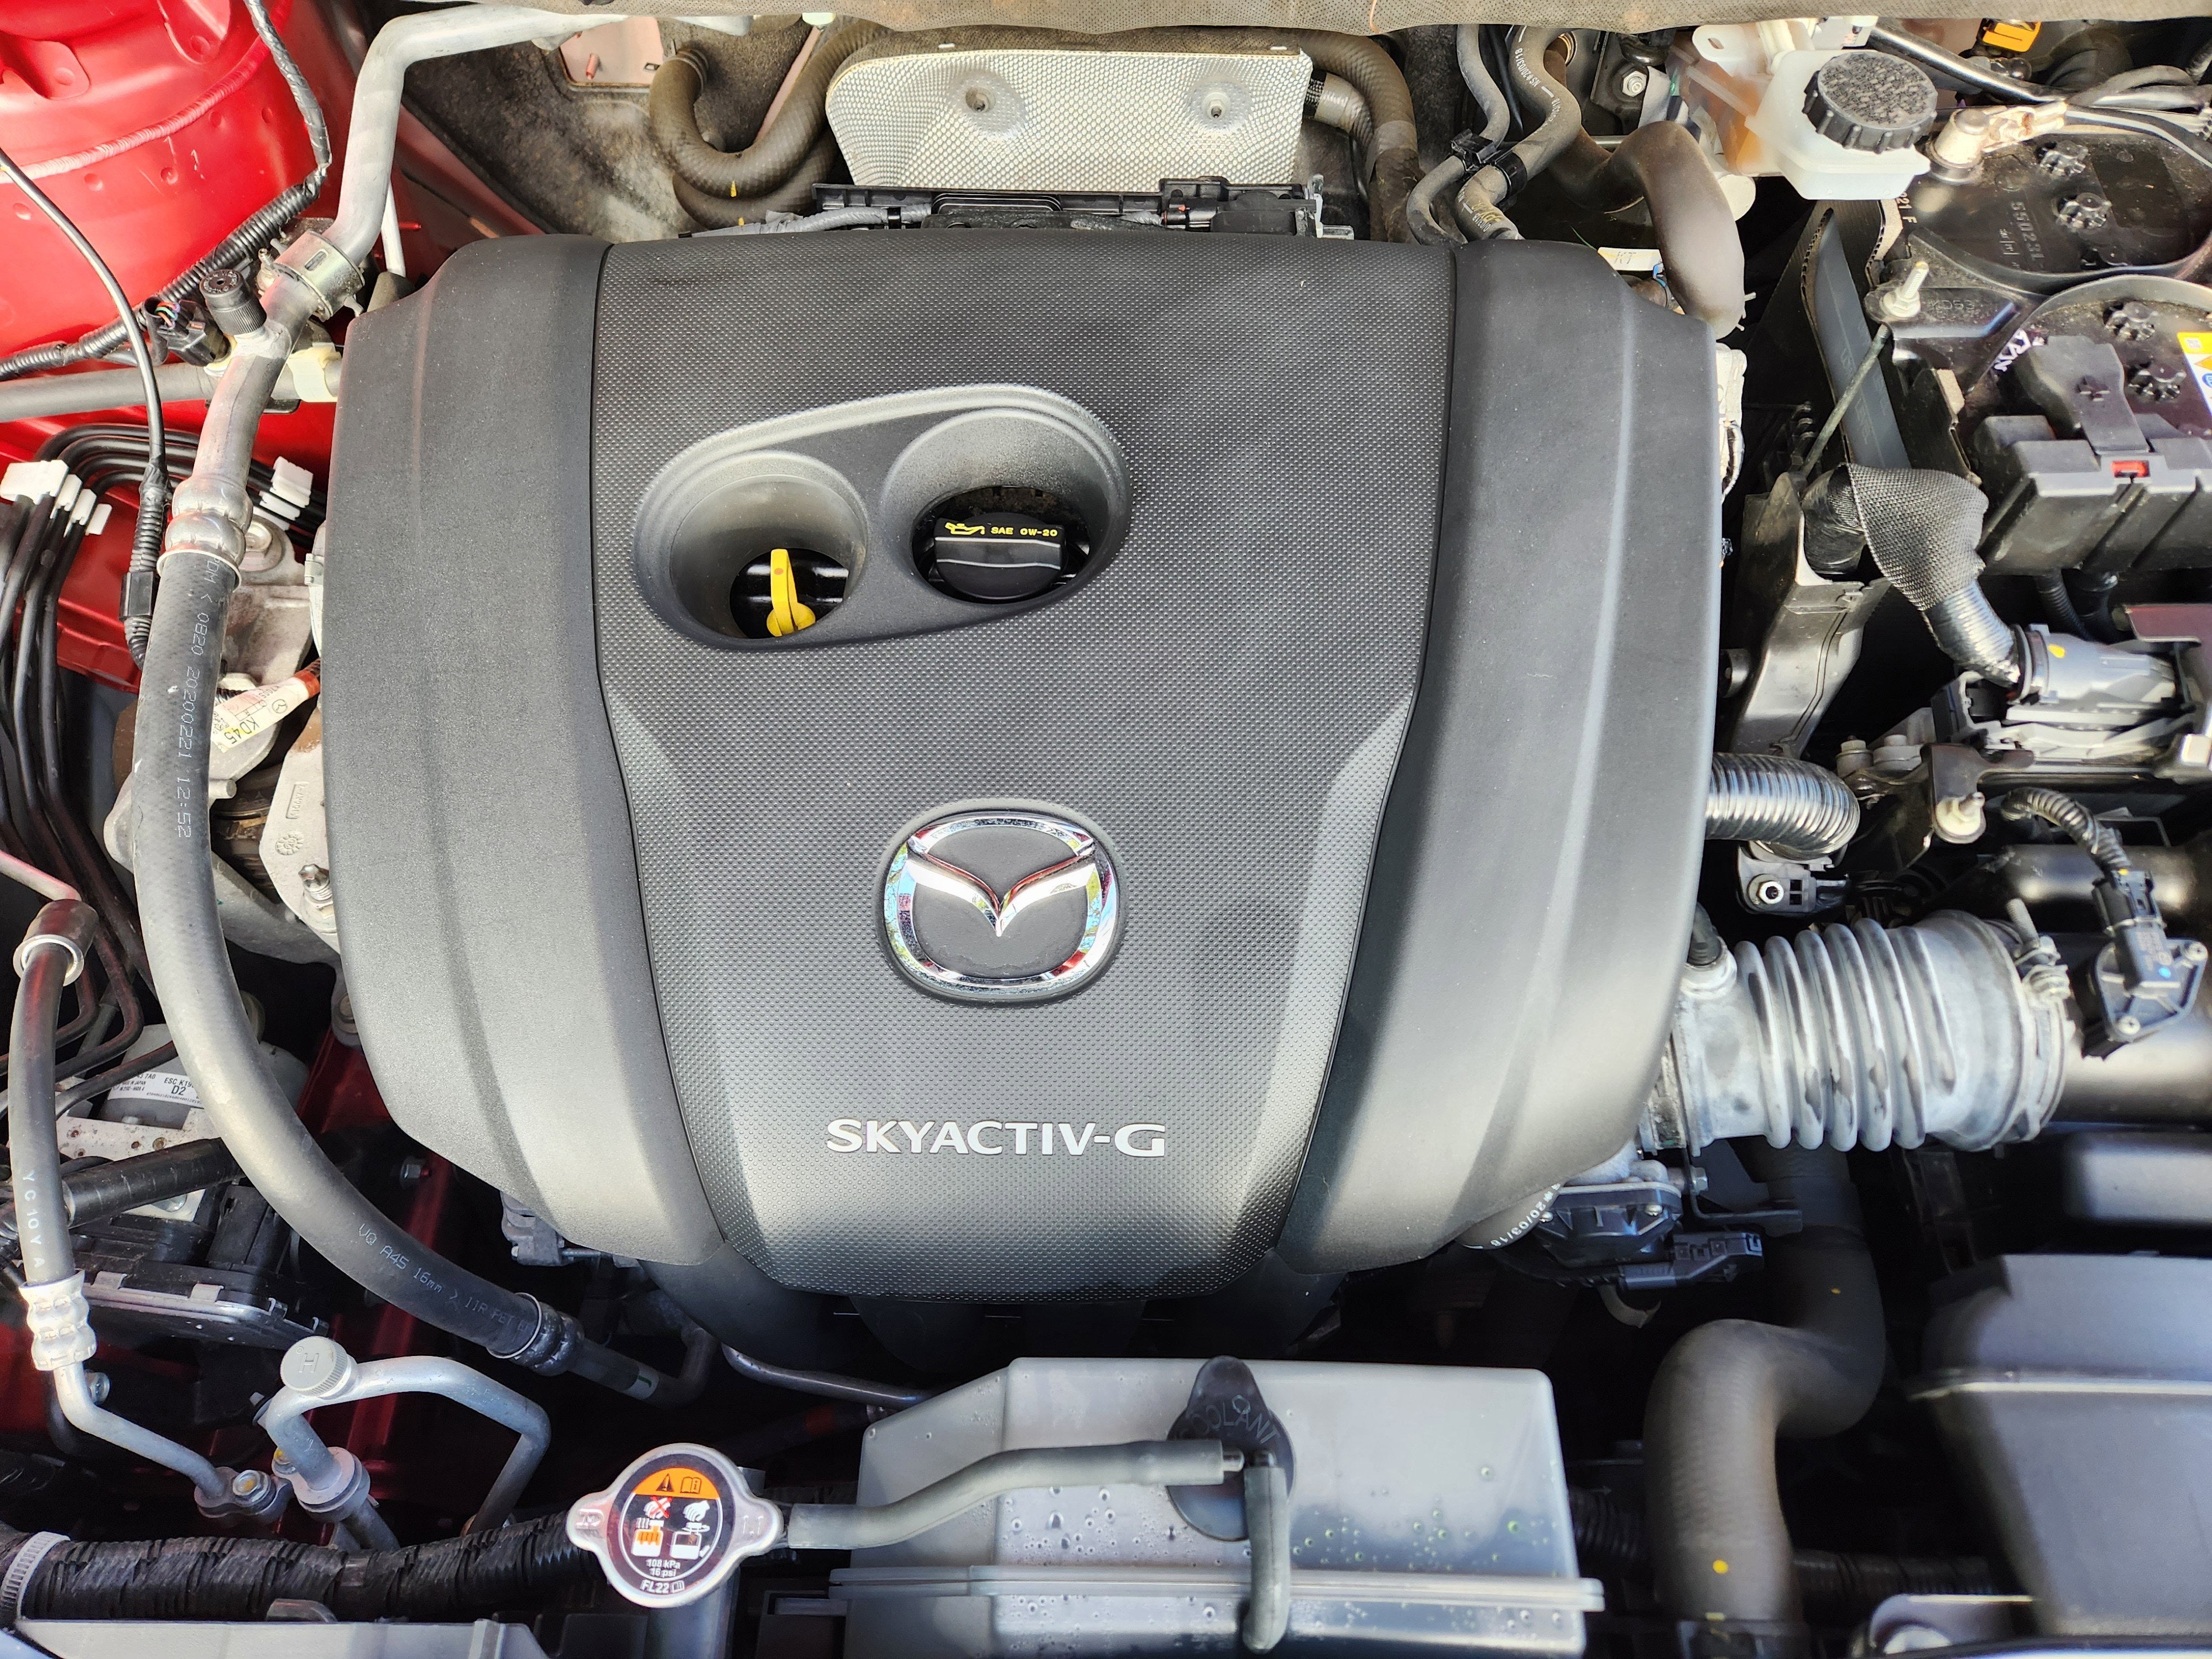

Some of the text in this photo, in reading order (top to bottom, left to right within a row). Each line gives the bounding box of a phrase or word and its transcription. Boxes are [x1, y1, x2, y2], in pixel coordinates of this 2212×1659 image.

[990, 526, 1058, 537] SAE 0W-20
[178, 666, 201, 758] 20200221
[224, 716, 260, 745] KD45
[176, 777, 191, 838] 12:52
[171, 1086, 186, 1096] D2
[179, 1080, 195, 1088] K19
[826, 1118, 1165, 1157] SKYACTIV-G
[379, 1245, 410, 1270] A45
[413, 1267, 442, 1293] 16mm
[299, 1353, 319, 1373] H
[645, 1559, 681, 1569] 108 kPa
[640, 1579, 670, 1593] FL22
